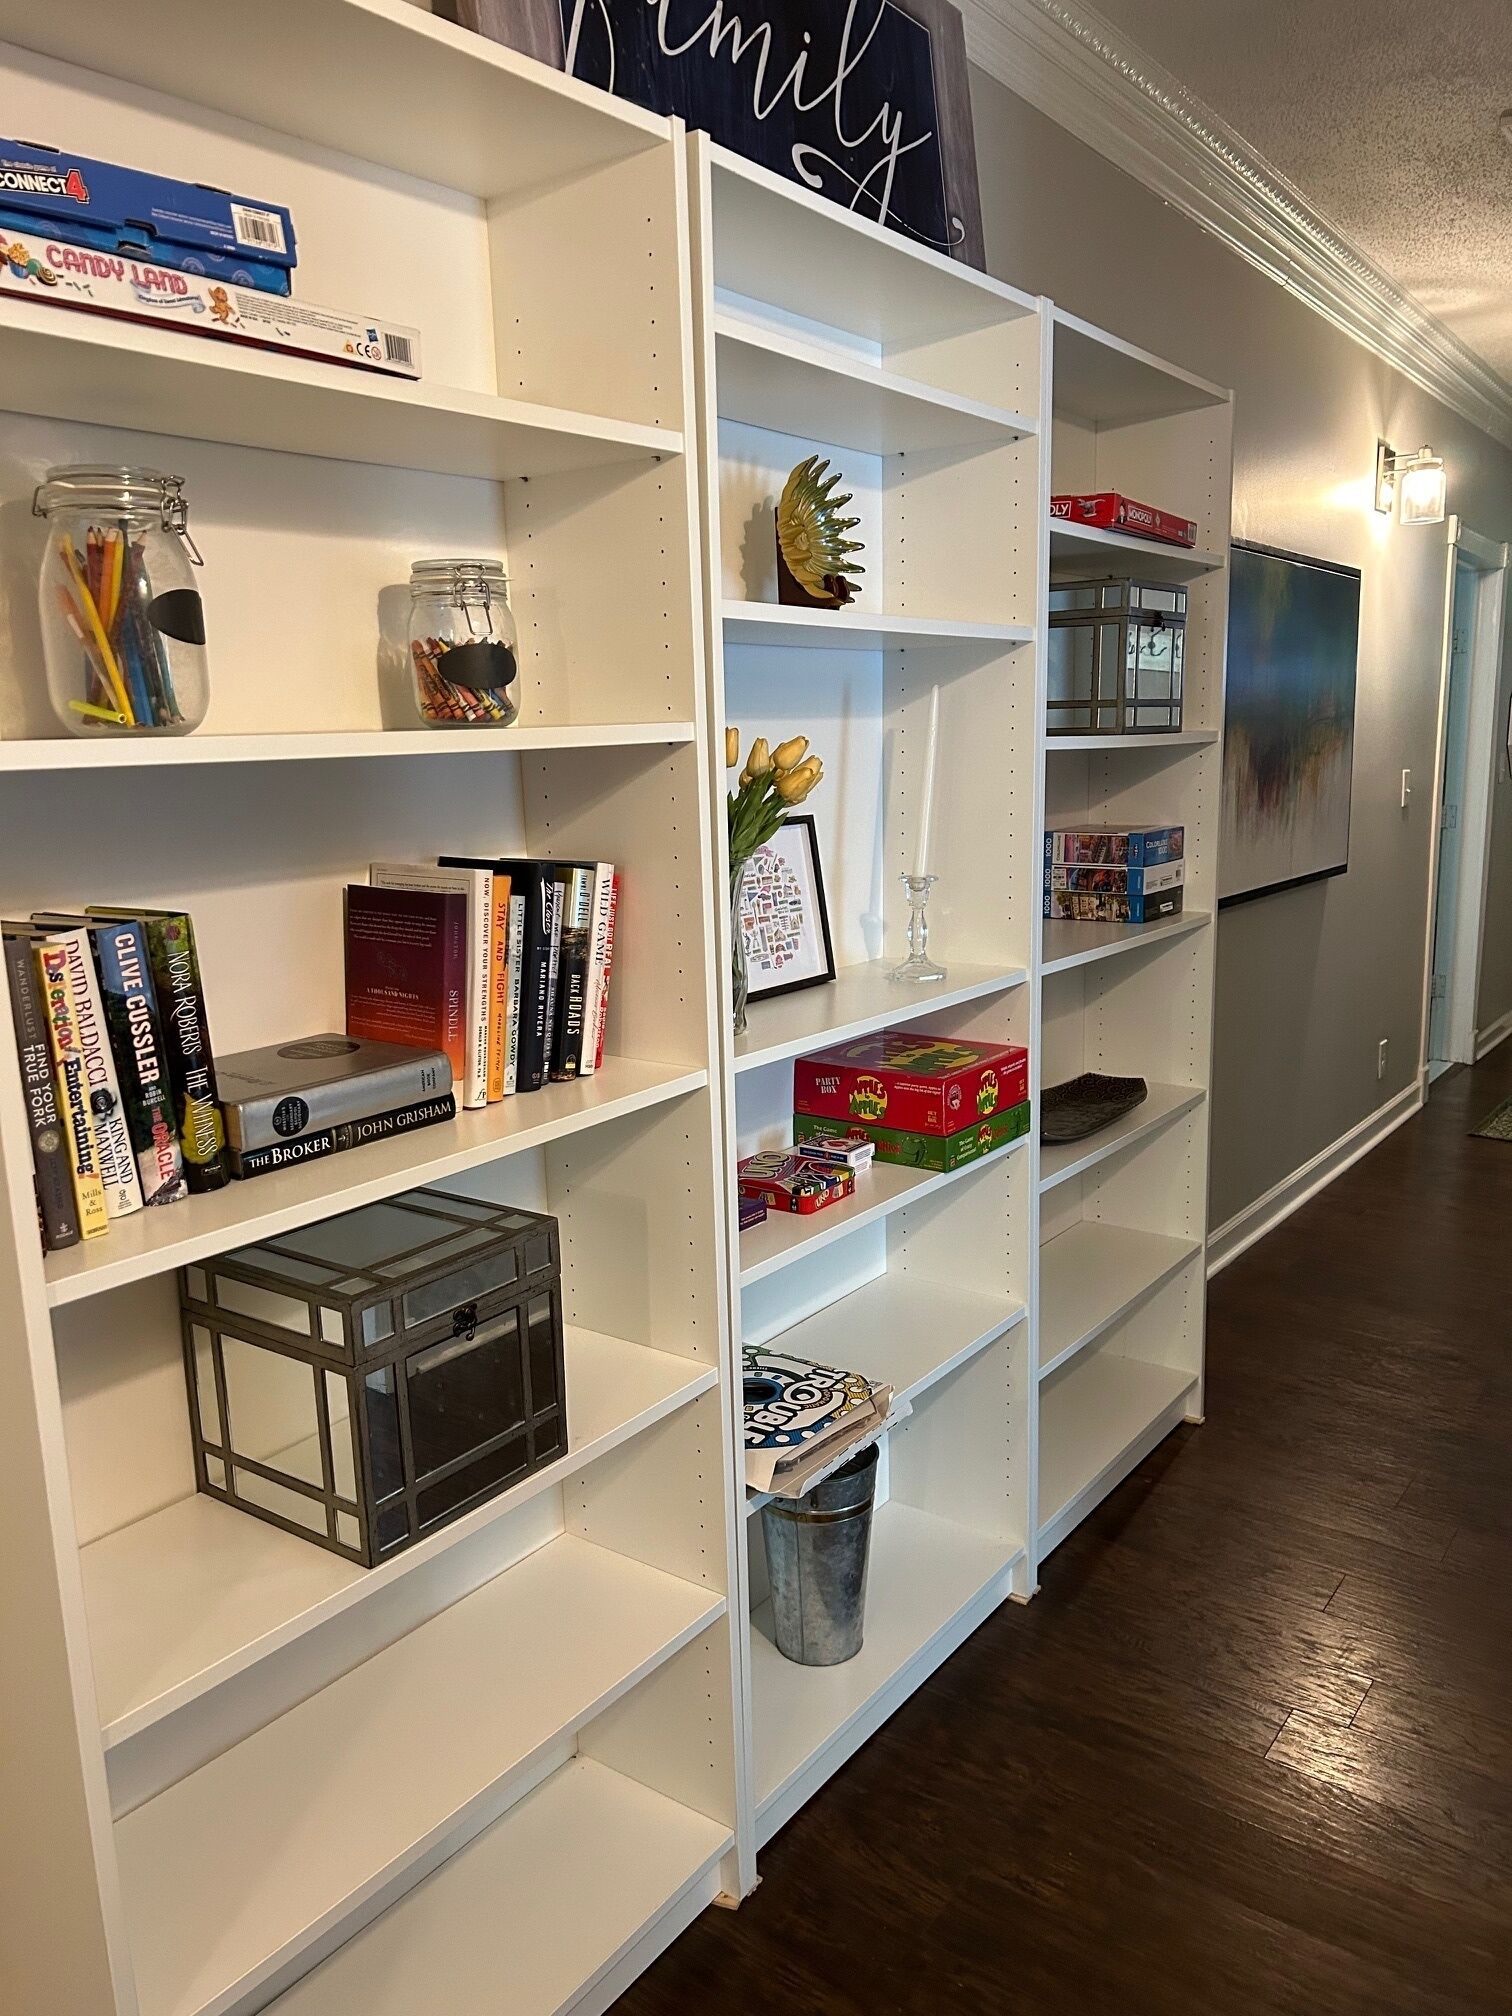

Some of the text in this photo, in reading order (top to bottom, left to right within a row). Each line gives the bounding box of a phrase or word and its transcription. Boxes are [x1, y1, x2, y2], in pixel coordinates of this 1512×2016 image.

[46, 244, 188, 295] CANDY LAND
[482, 902, 490, 945] DISCOVER
[546, 882, 554, 934] The Closer
[578, 892, 590, 922] O'DELL
[595, 878, 611, 966] WILD GAME
[608, 906, 616, 926] JUST
[496, 902, 506, 1005] STAY AND FIGHT
[607, 927, 615, 942] GOT
[604, 944, 613, 969] REAL
[16, 958, 38, 1041] WANDERLUST
[538, 961, 547, 1001] MARIANO
[65, 938, 108, 1087] DAVID BALDACCI
[114, 932, 160, 1085] CLIVE CUSSLER
[167, 950, 203, 1055] NORA ROBERTS
[448, 989, 459, 1042] SPINDLE
[512, 978, 520, 1027] BARBARA
[536, 1005, 544, 1037] RIVERA
[566, 973, 583, 1035] BACK ROADS
[509, 1029, 518, 1067] GOWDY
[23, 1044, 46, 1128] TRUE FORK
[35, 1043, 57, 1124] FIND YOUR
[142, 1095, 166, 1107] BURCELL
[145, 1089, 162, 1099] ROBIN
[815, 1076, 841, 1086] PARTY
[820, 1086, 837, 1094] BOX
[185, 1064, 219, 1157] THE WITNESS
[356, 1116, 394, 1141] JOHN
[396, 1101, 452, 1128] GRISHAM
[94, 1120, 120, 1191] MAXWELL
[109, 1117, 128, 1154] KING
[151, 1106, 176, 1181] THE ORACLE
[250, 1154, 271, 1169] THE
[271, 1136, 331, 1165] BROKER
[115, 1155, 134, 1185] AND
[739, 1151, 791, 1180] UNO
[81, 1188, 102, 1200] Mills
[85, 1207, 103, 1216] Ross
[815, 1189, 830, 1209] UNO
